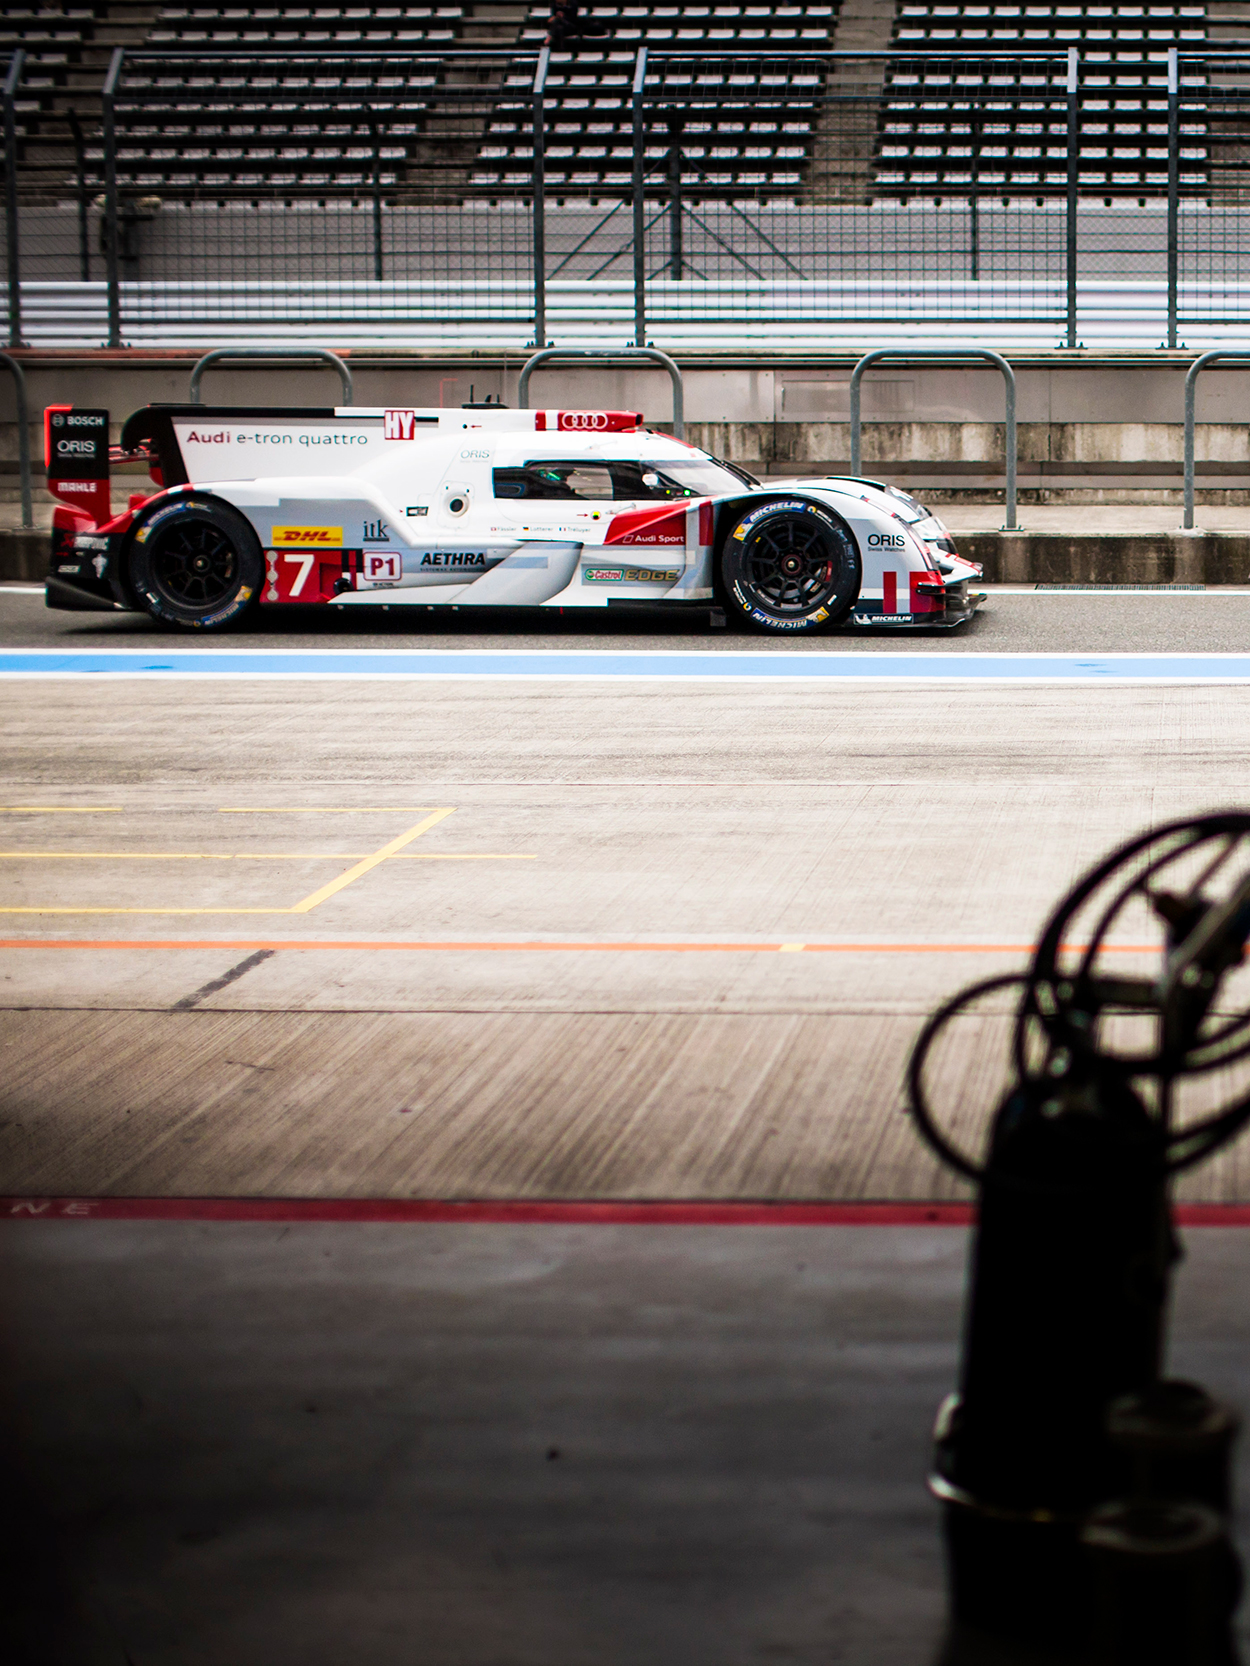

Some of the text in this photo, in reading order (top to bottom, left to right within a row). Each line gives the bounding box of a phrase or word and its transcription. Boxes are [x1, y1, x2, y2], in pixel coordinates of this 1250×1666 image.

[67, 416, 103, 426] BOSCH
[386, 412, 414, 439] HY
[186, 431, 368, 447] Audi e-tron quattro
[57, 440, 95, 452] ORIS
[460, 449, 490, 459] ORIS
[57, 482, 97, 492] MAHLE
[749, 501, 805, 522] MICHELIN
[363, 519, 389, 538] itk
[283, 531, 331, 541] DHL
[658, 535, 685, 543] Sport
[867, 534, 905, 547] ORIS
[420, 552, 485, 565] AETHRA
[370, 557, 395, 576] P1
[284, 554, 315, 597] 7
[594, 569, 680, 581] Castrol EDGE
[752, 612, 808, 629] MICHELIN
